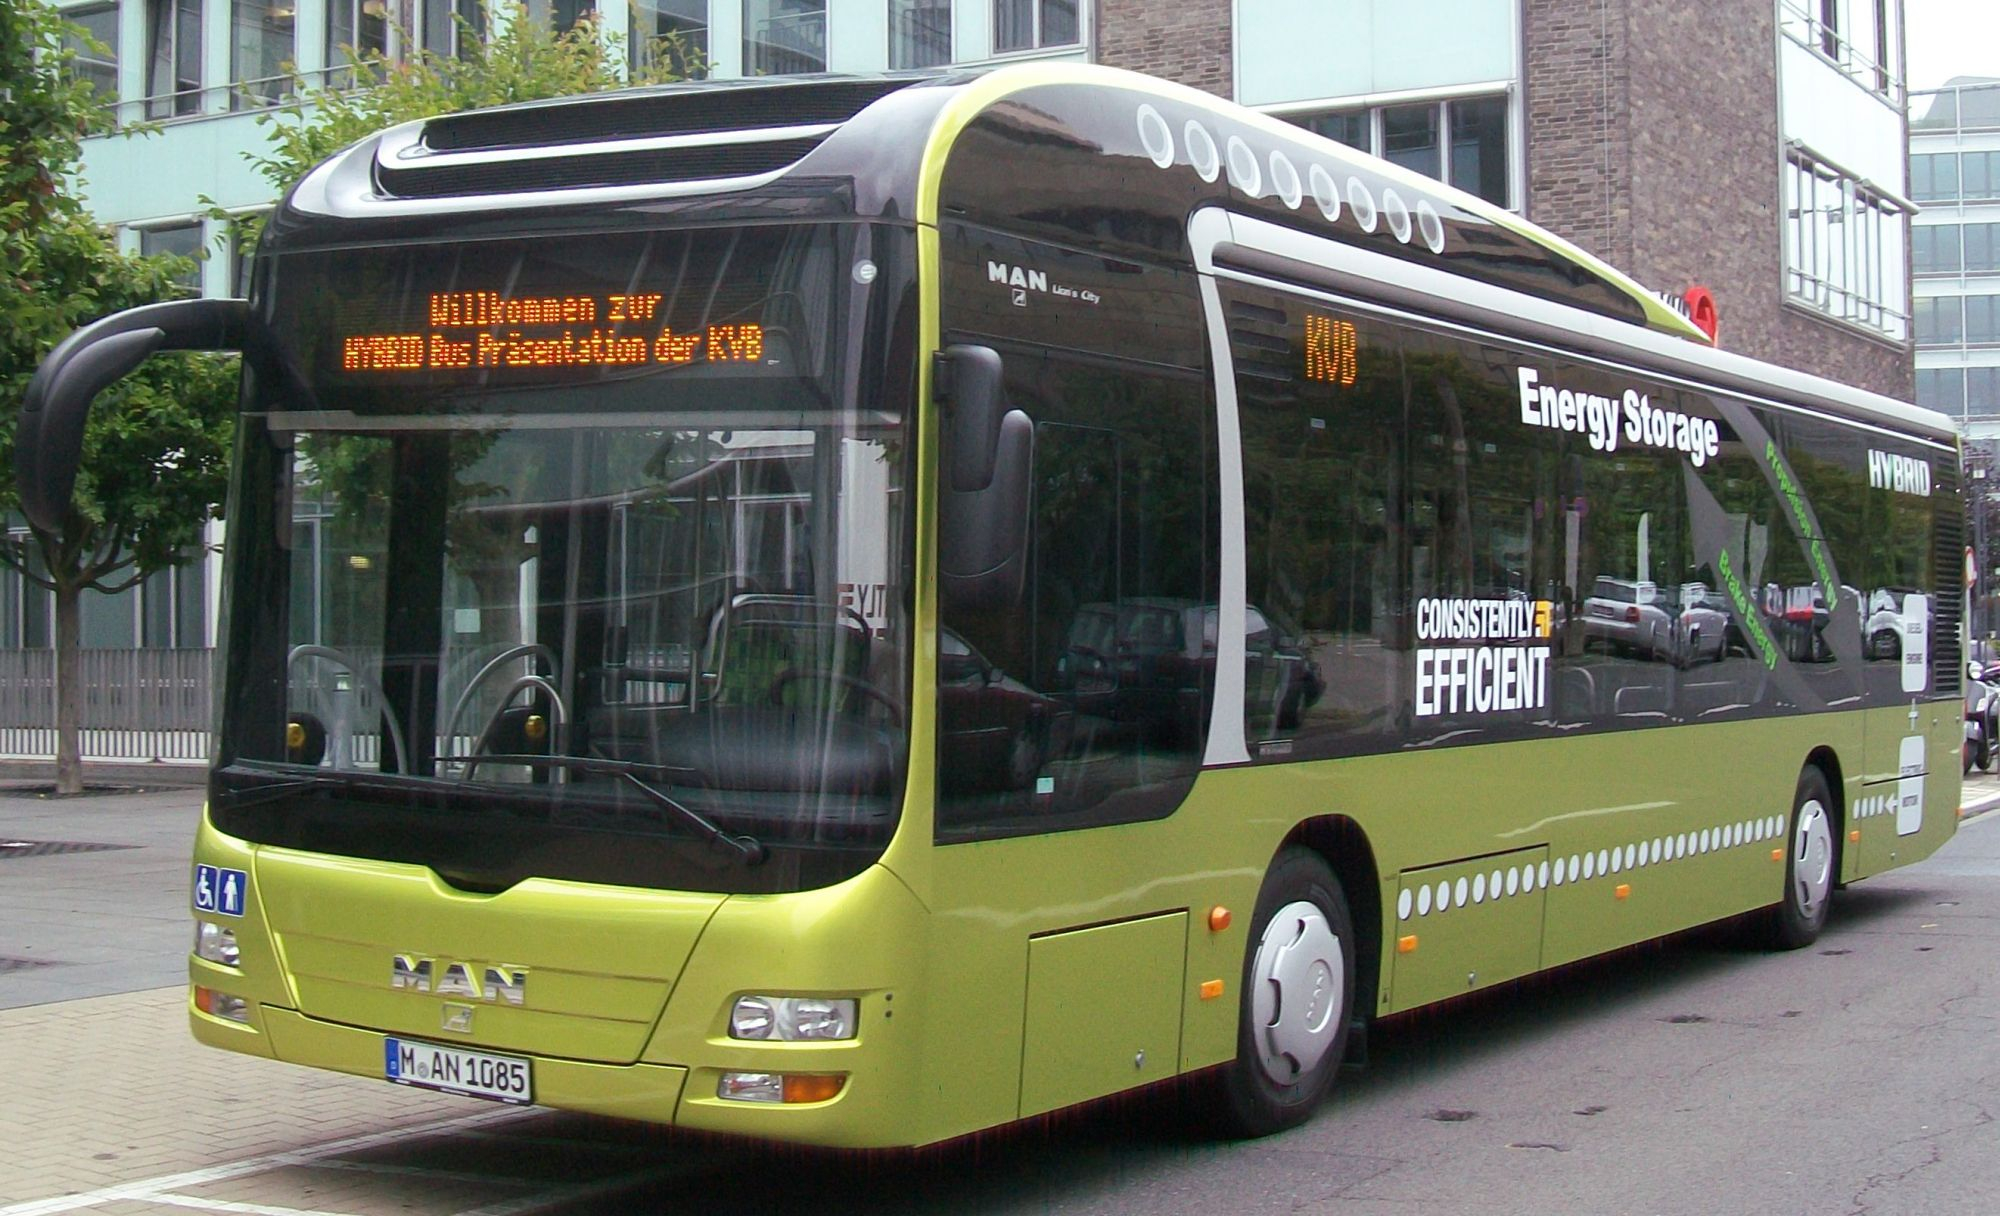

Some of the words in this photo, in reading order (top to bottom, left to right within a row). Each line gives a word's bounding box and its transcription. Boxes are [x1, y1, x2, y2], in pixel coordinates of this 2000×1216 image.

[988, 261, 1047, 292] MAN
[1080, 289, 1100, 304] City
[431, 292, 595, 326] Willkommen
[608, 295, 662, 320] zur
[345, 336, 424, 369] HYBRID
[430, 334, 472, 367] Bus
[478, 328, 646, 367] Präsentation
[654, 328, 700, 361] der
[708, 325, 762, 360] KVB
[1306, 315, 1356, 384] KVB
[1518, 366, 1619, 452] Energy
[1623, 389, 1719, 467] Storage
[1868, 448, 1931, 497] HYBRID
[1417, 598, 1536, 640] CONSISTENTLY
[1415, 647, 1550, 716] EFFICIENT
[391, 953, 530, 1005] MAN
[400, 1046, 415, 1075] M
[466, 1057, 525, 1093] 1085
